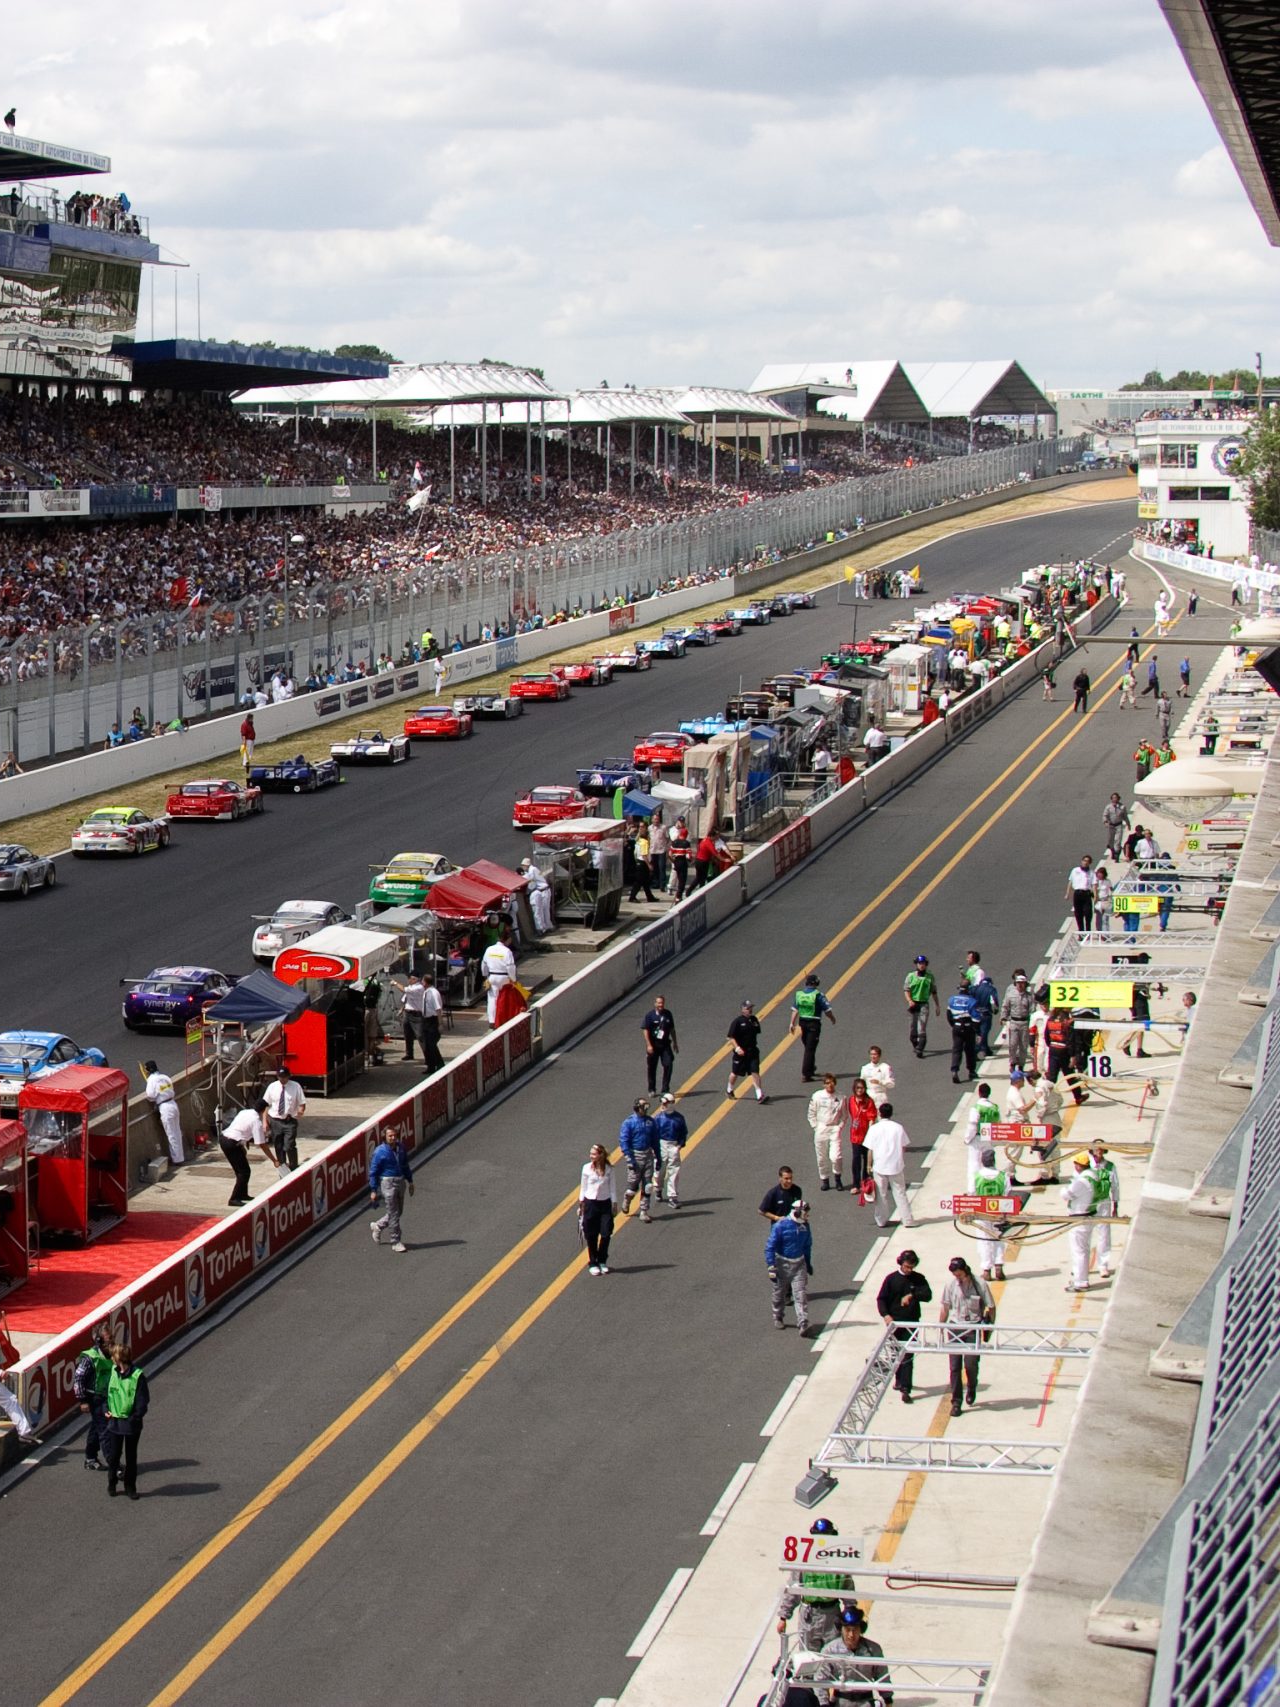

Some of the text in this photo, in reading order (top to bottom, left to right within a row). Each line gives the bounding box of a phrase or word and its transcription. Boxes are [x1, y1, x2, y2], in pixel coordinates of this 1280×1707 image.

[1187, 840, 1199, 850] 69
[1115, 898, 1129, 911] 90
[310, 965, 333, 973] racing
[1055, 986, 1080, 1002] 32
[144, 999, 177, 1012] synergy
[1089, 1055, 1112, 1078] 18
[329, 1155, 366, 1196] TOTAL
[271, 1191, 311, 1238] TOTAL
[940, 1200, 953, 1210] 62
[206, 1235, 251, 1286] TOTAL
[134, 1286, 184, 1339] TOTAL
[784, 1536, 861, 1563] 87 orbit
